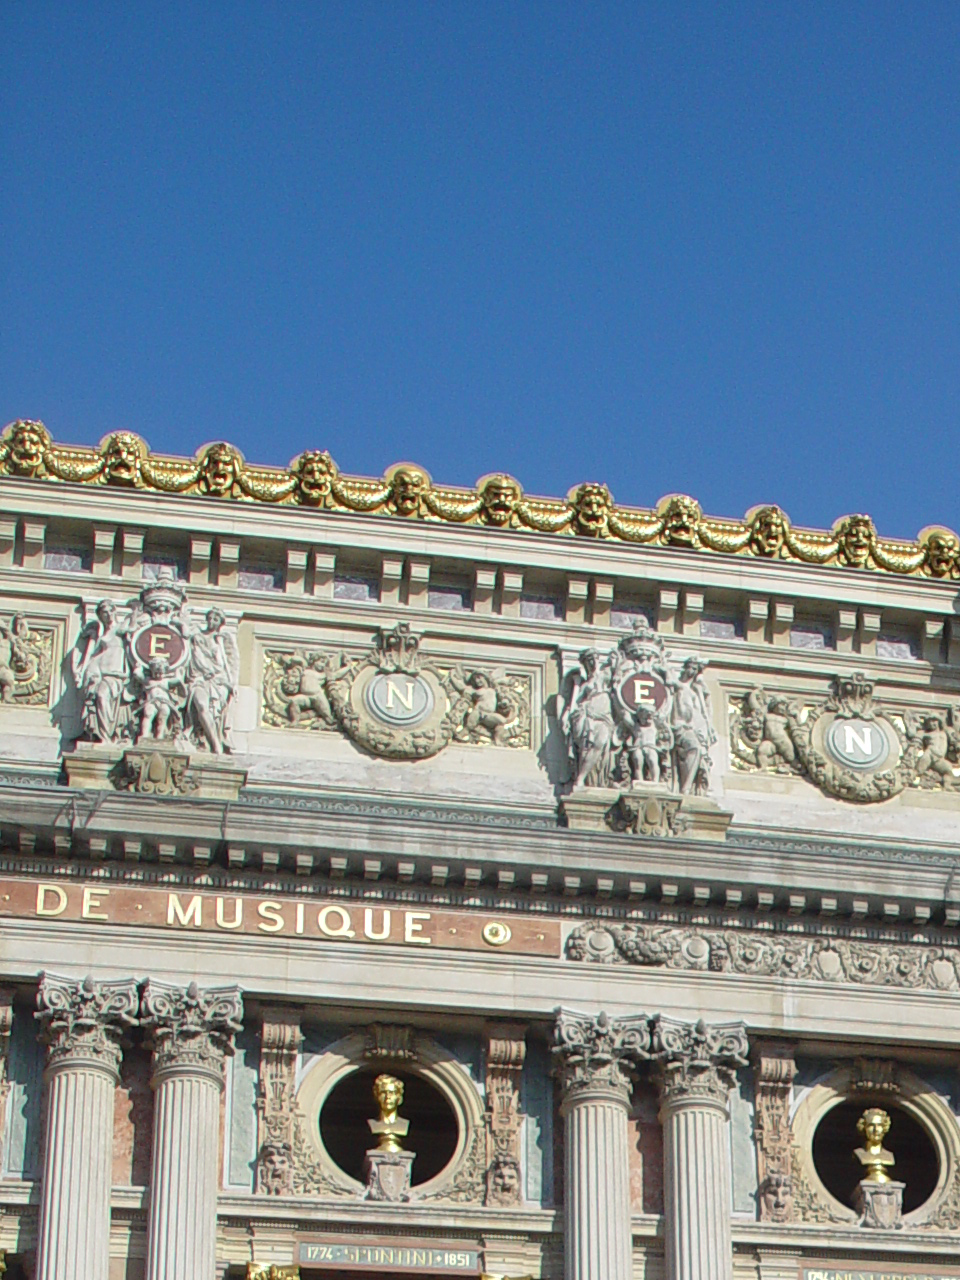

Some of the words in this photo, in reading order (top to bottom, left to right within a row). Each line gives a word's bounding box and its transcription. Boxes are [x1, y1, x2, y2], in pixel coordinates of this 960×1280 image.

[148, 633, 171, 658] E
[386, 681, 415, 710] N
[634, 680, 656, 705] E
[843, 726, 872, 755] N
[35, 884, 110, 921] DE
[167, 894, 432, 945] MUSIQUE
[307, 1247, 333, 1260] 1774
[444, 1253, 470, 1267] 1851
